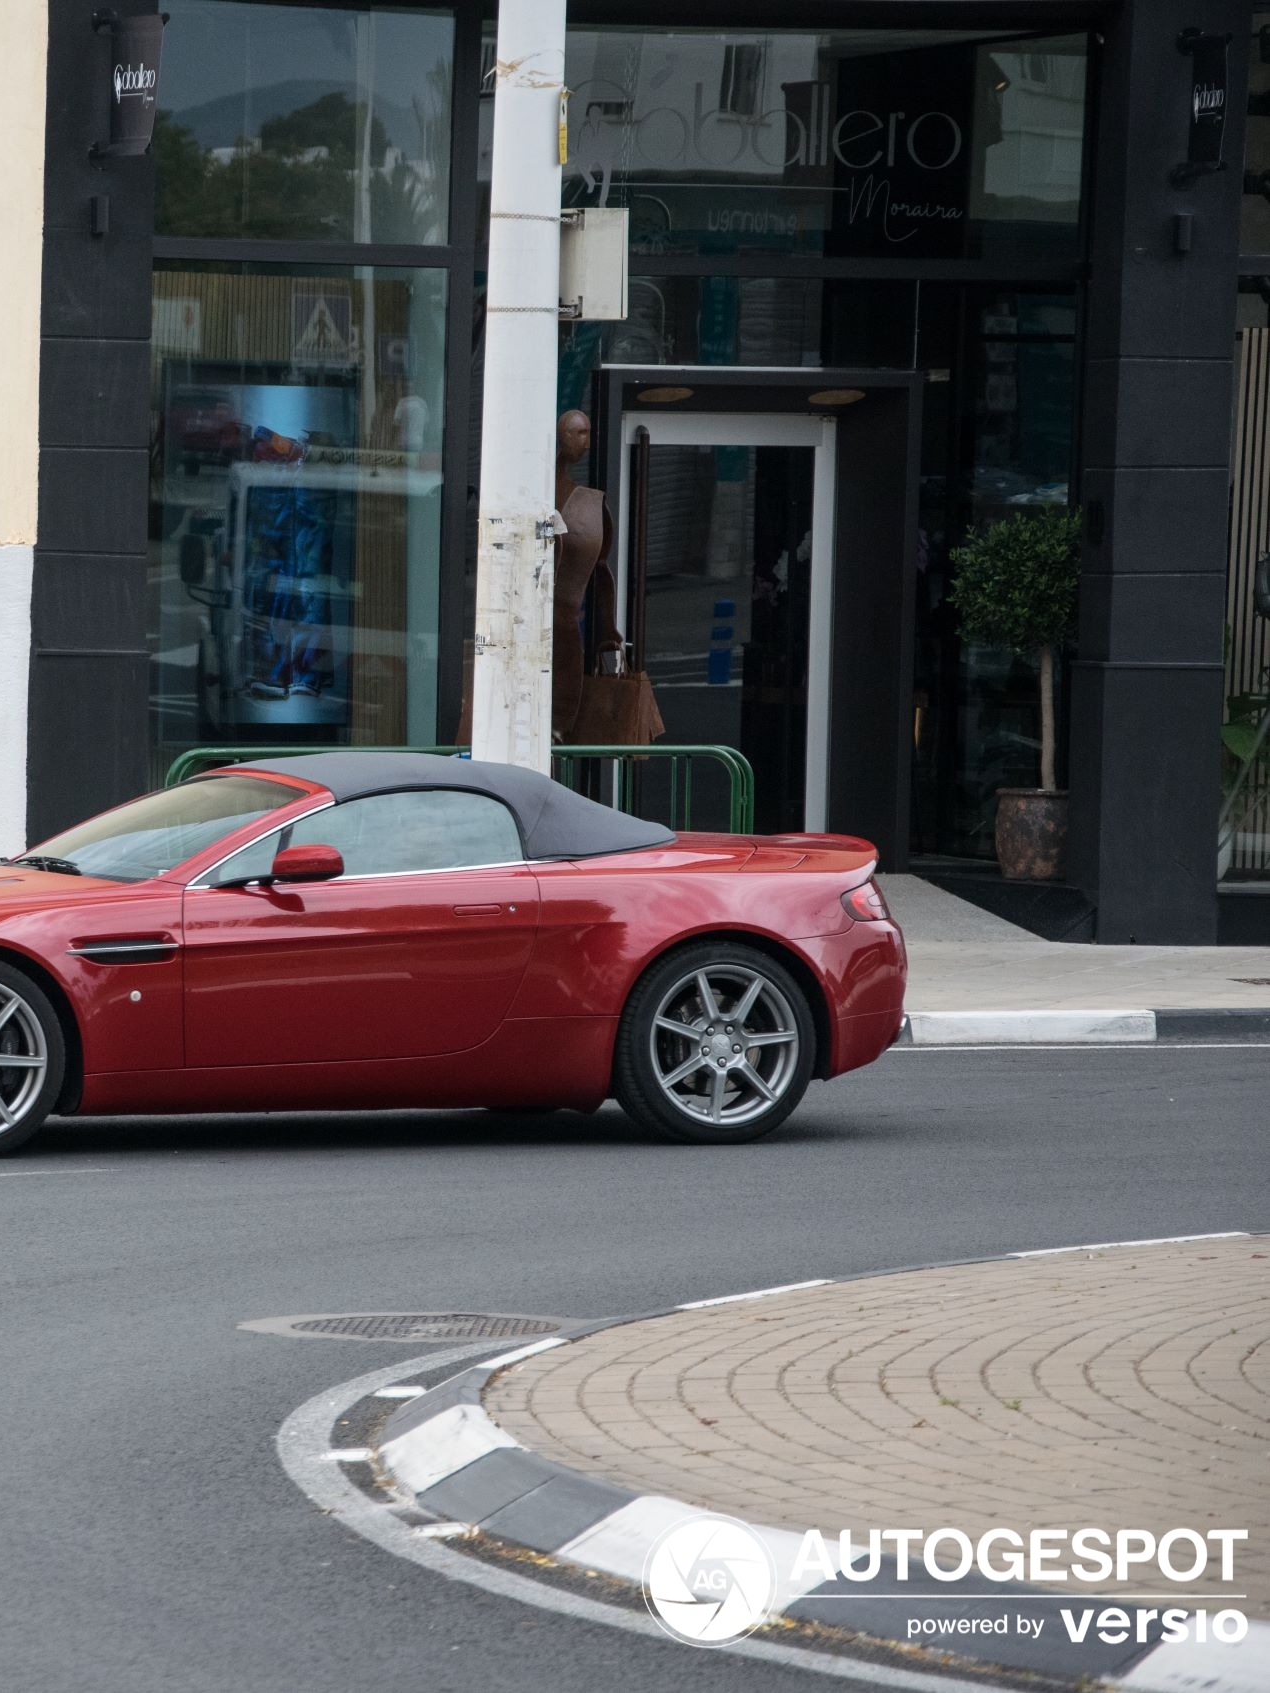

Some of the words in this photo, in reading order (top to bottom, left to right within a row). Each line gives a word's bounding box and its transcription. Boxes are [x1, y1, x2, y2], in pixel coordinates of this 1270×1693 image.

[114, 63, 156, 94] Caballero
[562, 79, 963, 171] Caballero
[848, 174, 963, 242] Moraira
